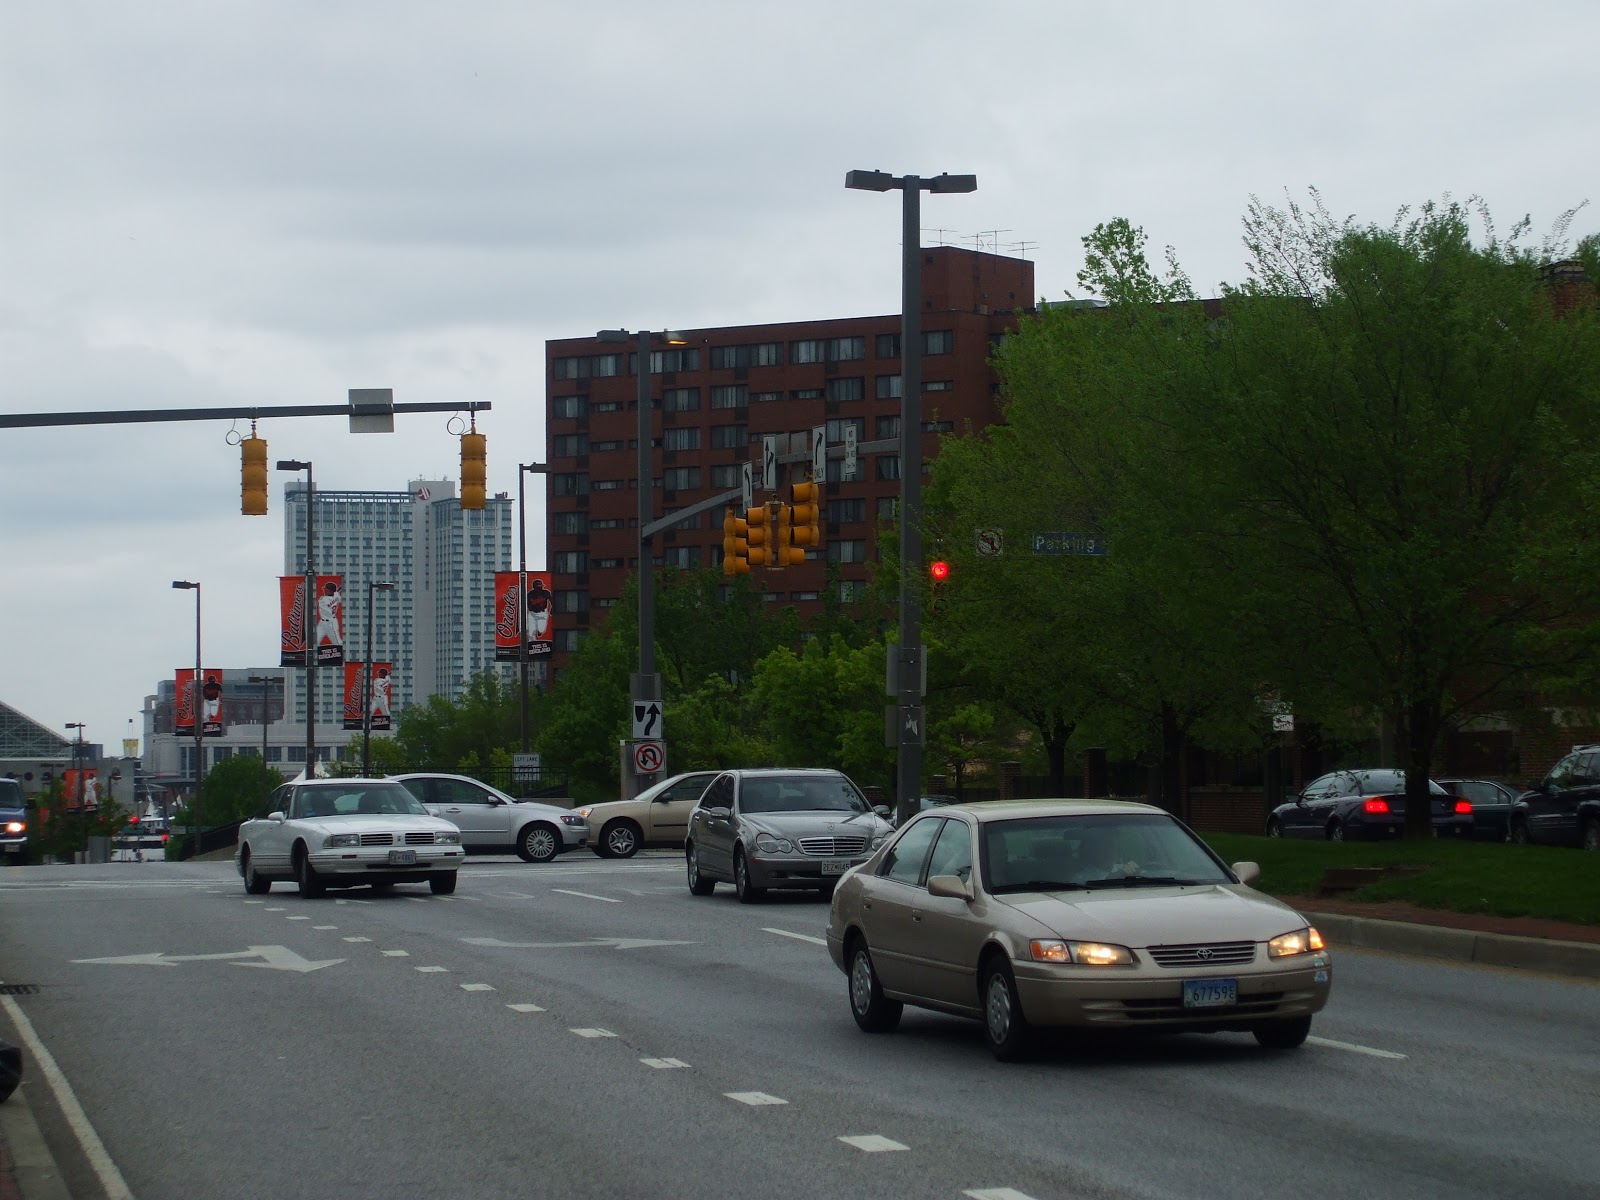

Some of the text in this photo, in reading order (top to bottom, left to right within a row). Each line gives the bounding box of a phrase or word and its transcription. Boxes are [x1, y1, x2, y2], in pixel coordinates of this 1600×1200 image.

[1036, 536, 1095, 553] Parking
[281, 583, 304, 651] Baltimore
[496, 585, 518, 639] Orioles
